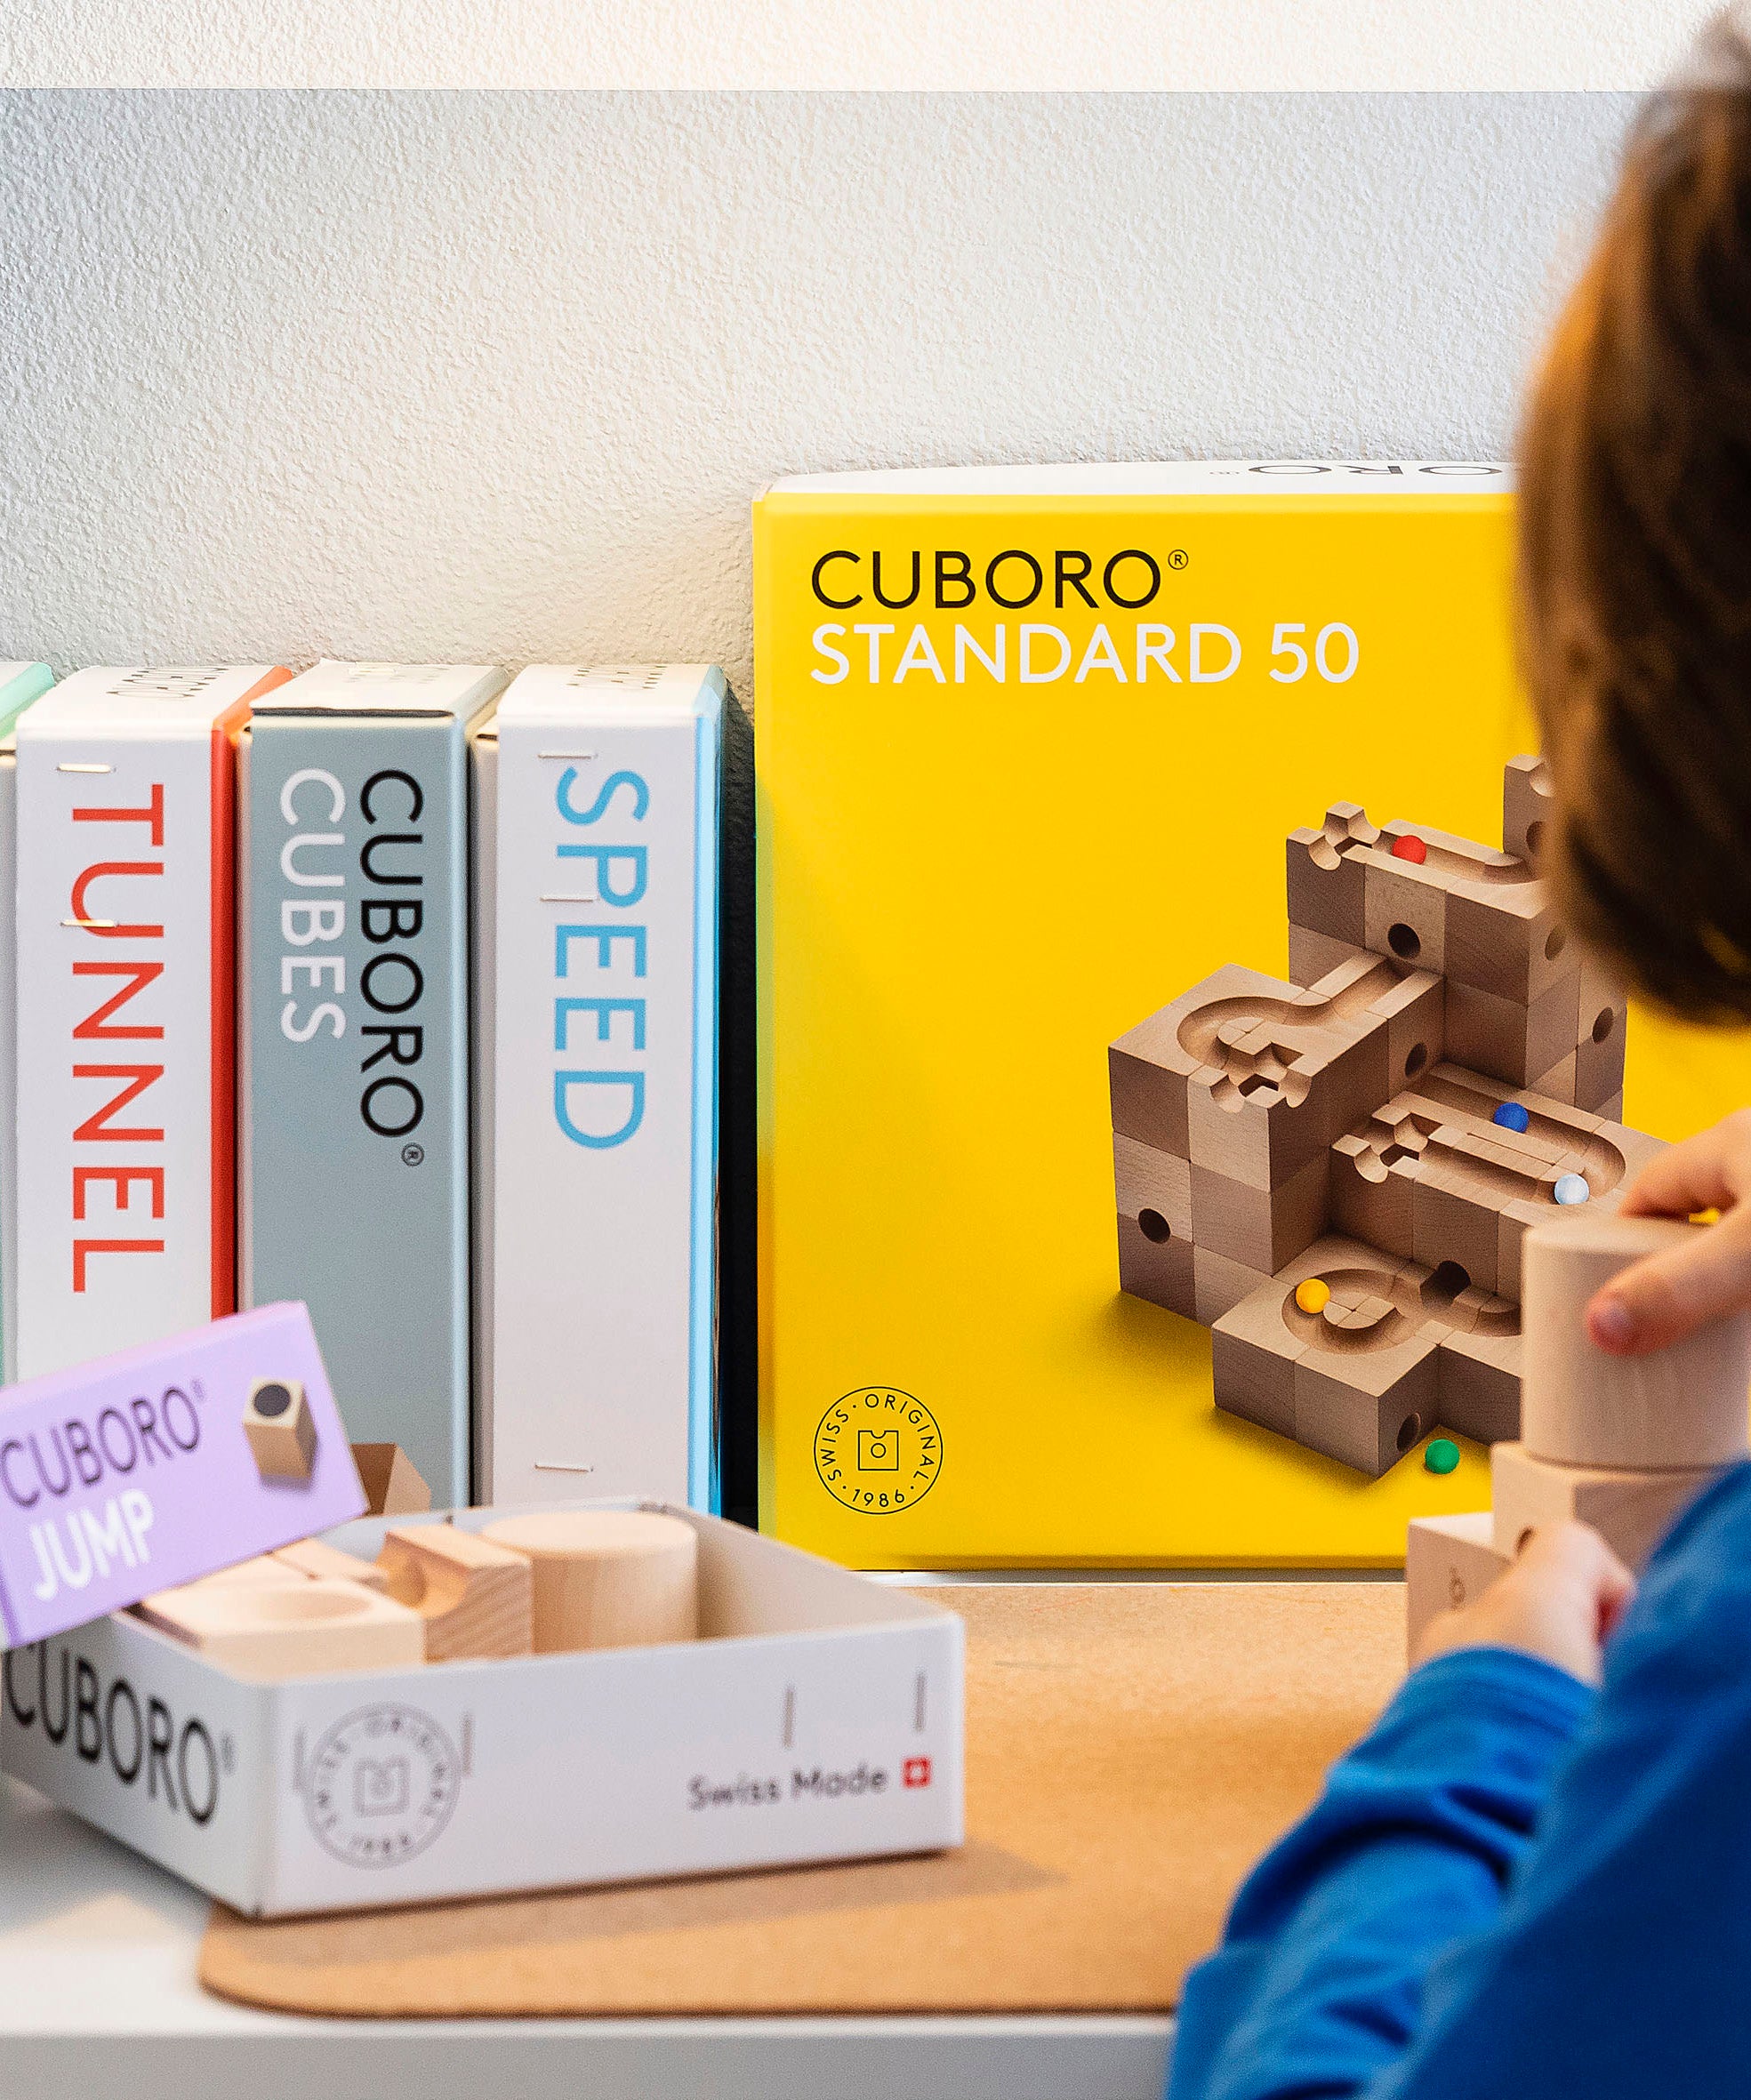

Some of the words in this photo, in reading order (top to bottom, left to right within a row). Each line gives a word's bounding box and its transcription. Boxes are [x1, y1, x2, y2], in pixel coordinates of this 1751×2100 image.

[810, 623, 1242, 685] STANDARD
[1269, 621, 1360, 684] 50
[279, 767, 347, 1043] CUBES
[554, 766, 650, 1150] SPEED
[71, 783, 165, 1293] TUNNEL
[820, 1408, 849, 1482] SWISS
[864, 1393, 936, 1479] ORIGINAL
[29, 1489, 155, 1600] JUMP
[851, 1488, 905, 1508] 1986
